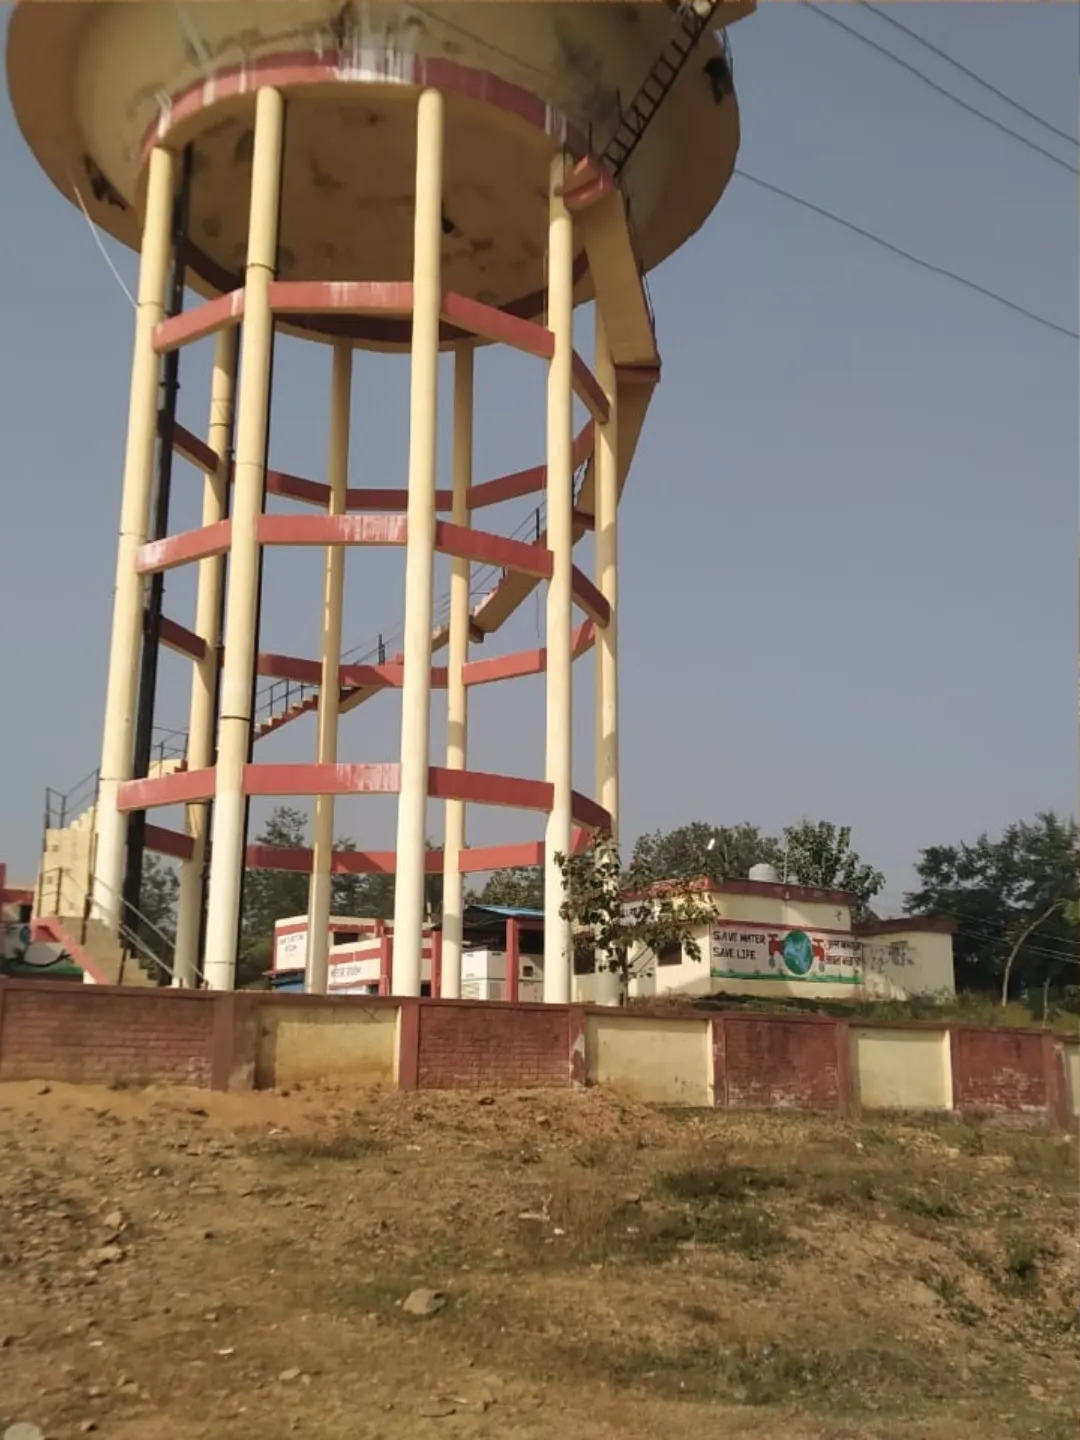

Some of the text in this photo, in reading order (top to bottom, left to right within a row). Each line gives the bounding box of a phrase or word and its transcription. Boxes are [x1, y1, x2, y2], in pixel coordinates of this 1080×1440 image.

[713, 930, 737, 942] SAVE
[713, 946, 756, 960] SAVE LIFE
